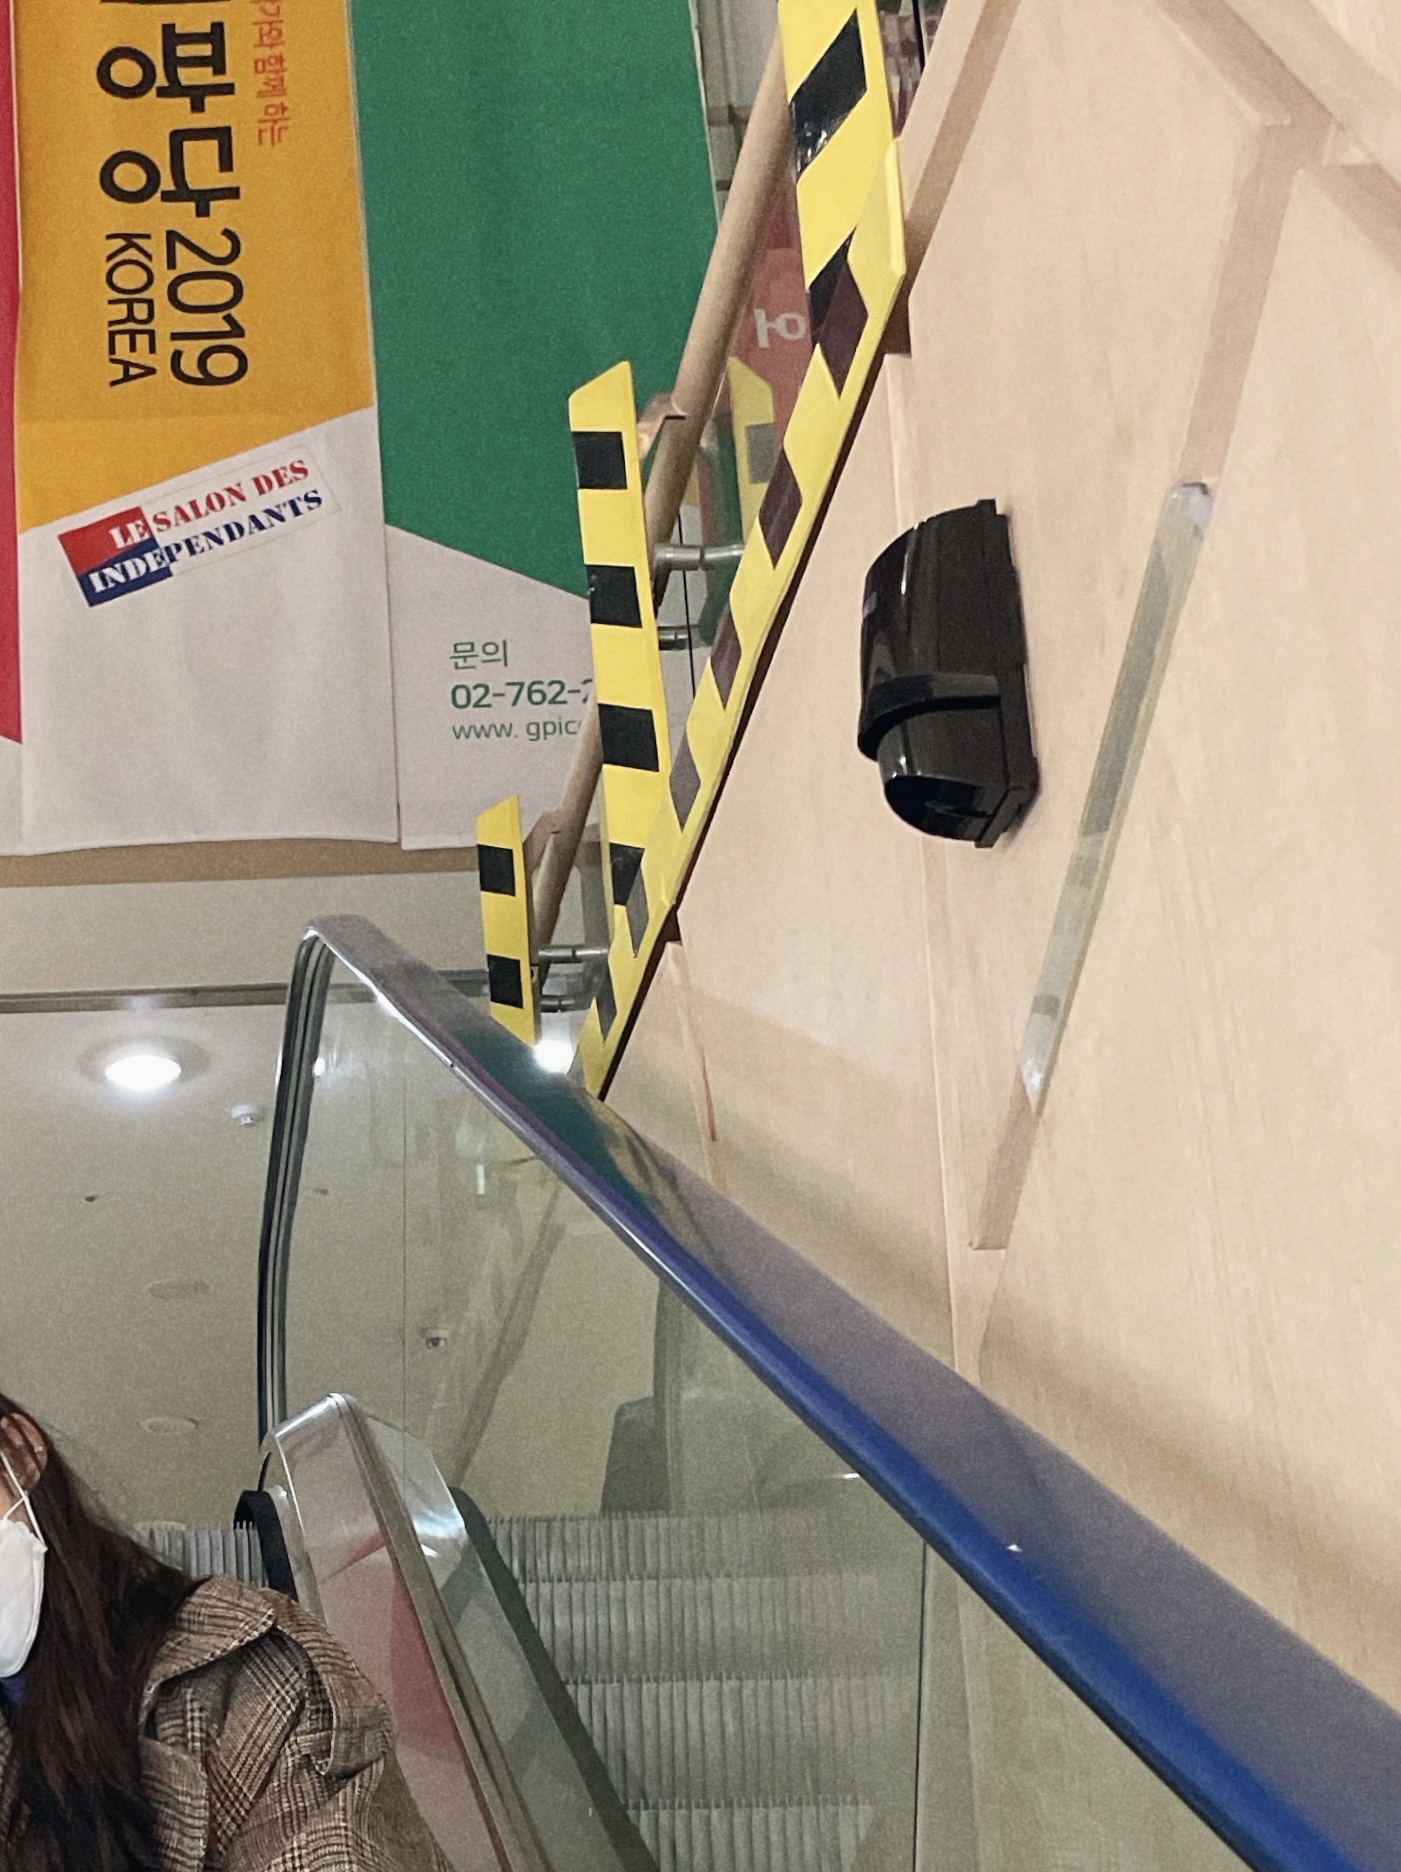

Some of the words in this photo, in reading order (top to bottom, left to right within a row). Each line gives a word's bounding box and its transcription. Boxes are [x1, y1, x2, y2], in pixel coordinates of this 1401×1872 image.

[254, 53, 287, 98] 함께
[257, 102, 290, 146] 하는
[105, 232, 157, 387] KOREA
[166, 228, 248, 386] 2019
[88, 489, 323, 593] INDEPENDANTS
[108, 519, 154, 550] LE
[152, 483, 248, 532] SALON
[253, 459, 309, 496] DES
[450, 640, 508, 670] 문의
